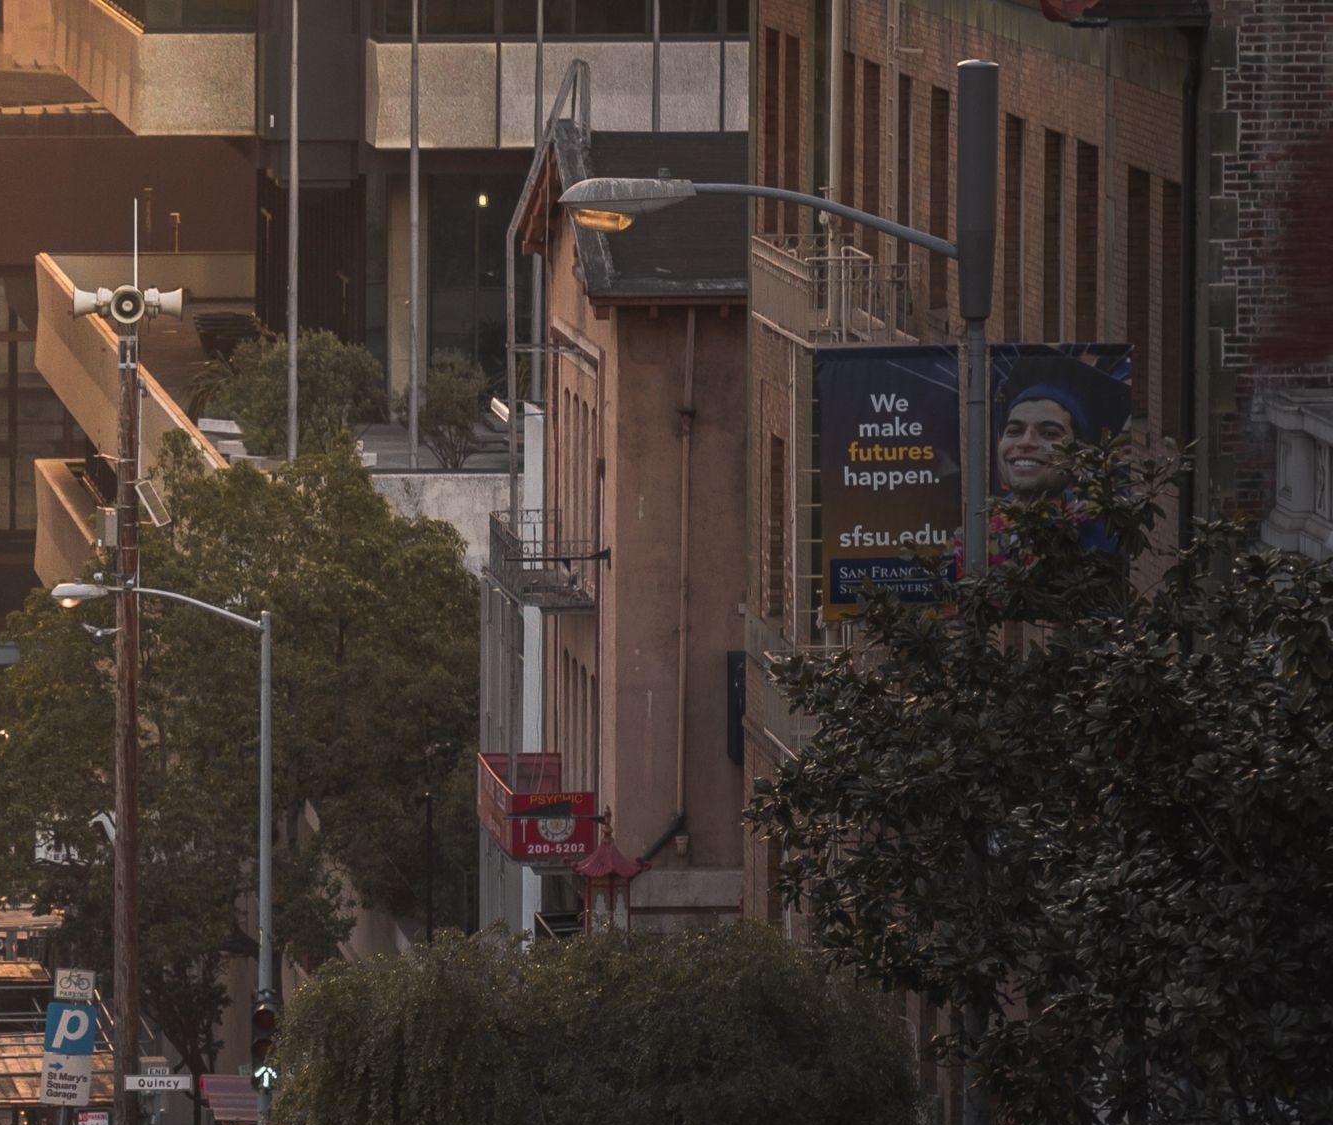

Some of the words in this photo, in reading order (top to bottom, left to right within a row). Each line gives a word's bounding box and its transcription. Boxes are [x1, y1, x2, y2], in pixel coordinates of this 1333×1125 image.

[870, 393, 909, 413] We
[859, 416, 923, 438] make
[848, 441, 934, 462] futures
[844, 466, 940, 490] happen.
[839, 524, 947, 547] sfsu.edu
[528, 843, 585, 854] 200-5202
[47, 1071, 57, 1080] St
[59, 1073, 88, 1083] Mary's
[138, 1079, 180, 1089] Quincy
[46, 1081, 77, 1090] Square
[45, 1089, 78, 1099] Garage
